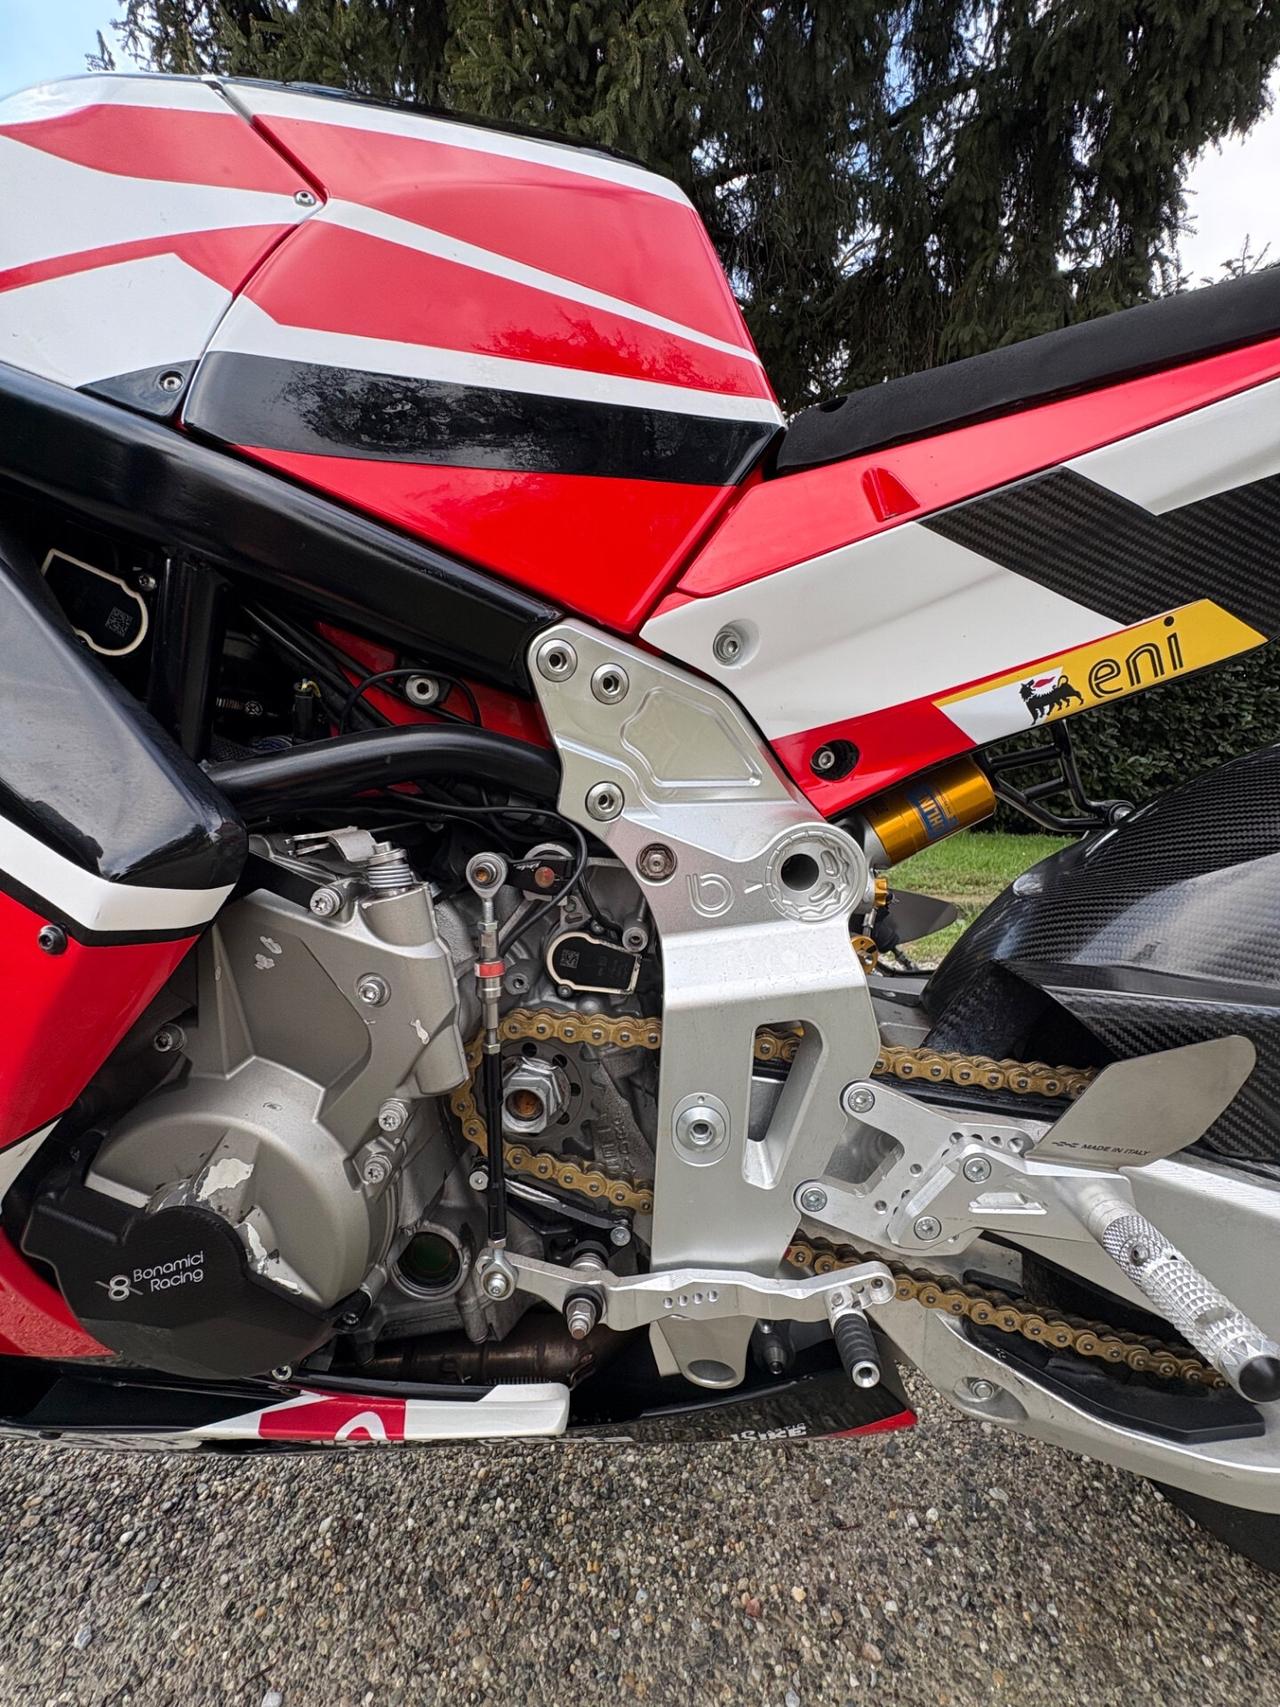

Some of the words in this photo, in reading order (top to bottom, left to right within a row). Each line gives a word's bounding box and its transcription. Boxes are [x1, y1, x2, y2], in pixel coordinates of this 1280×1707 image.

[1088, 616, 1184, 698] eni
[1081, 1144, 1111, 1152] MADE
[1124, 1148, 1151, 1156] ITALY
[133, 1250, 204, 1282] Bonamici
[150, 1269, 204, 1292] Racing
